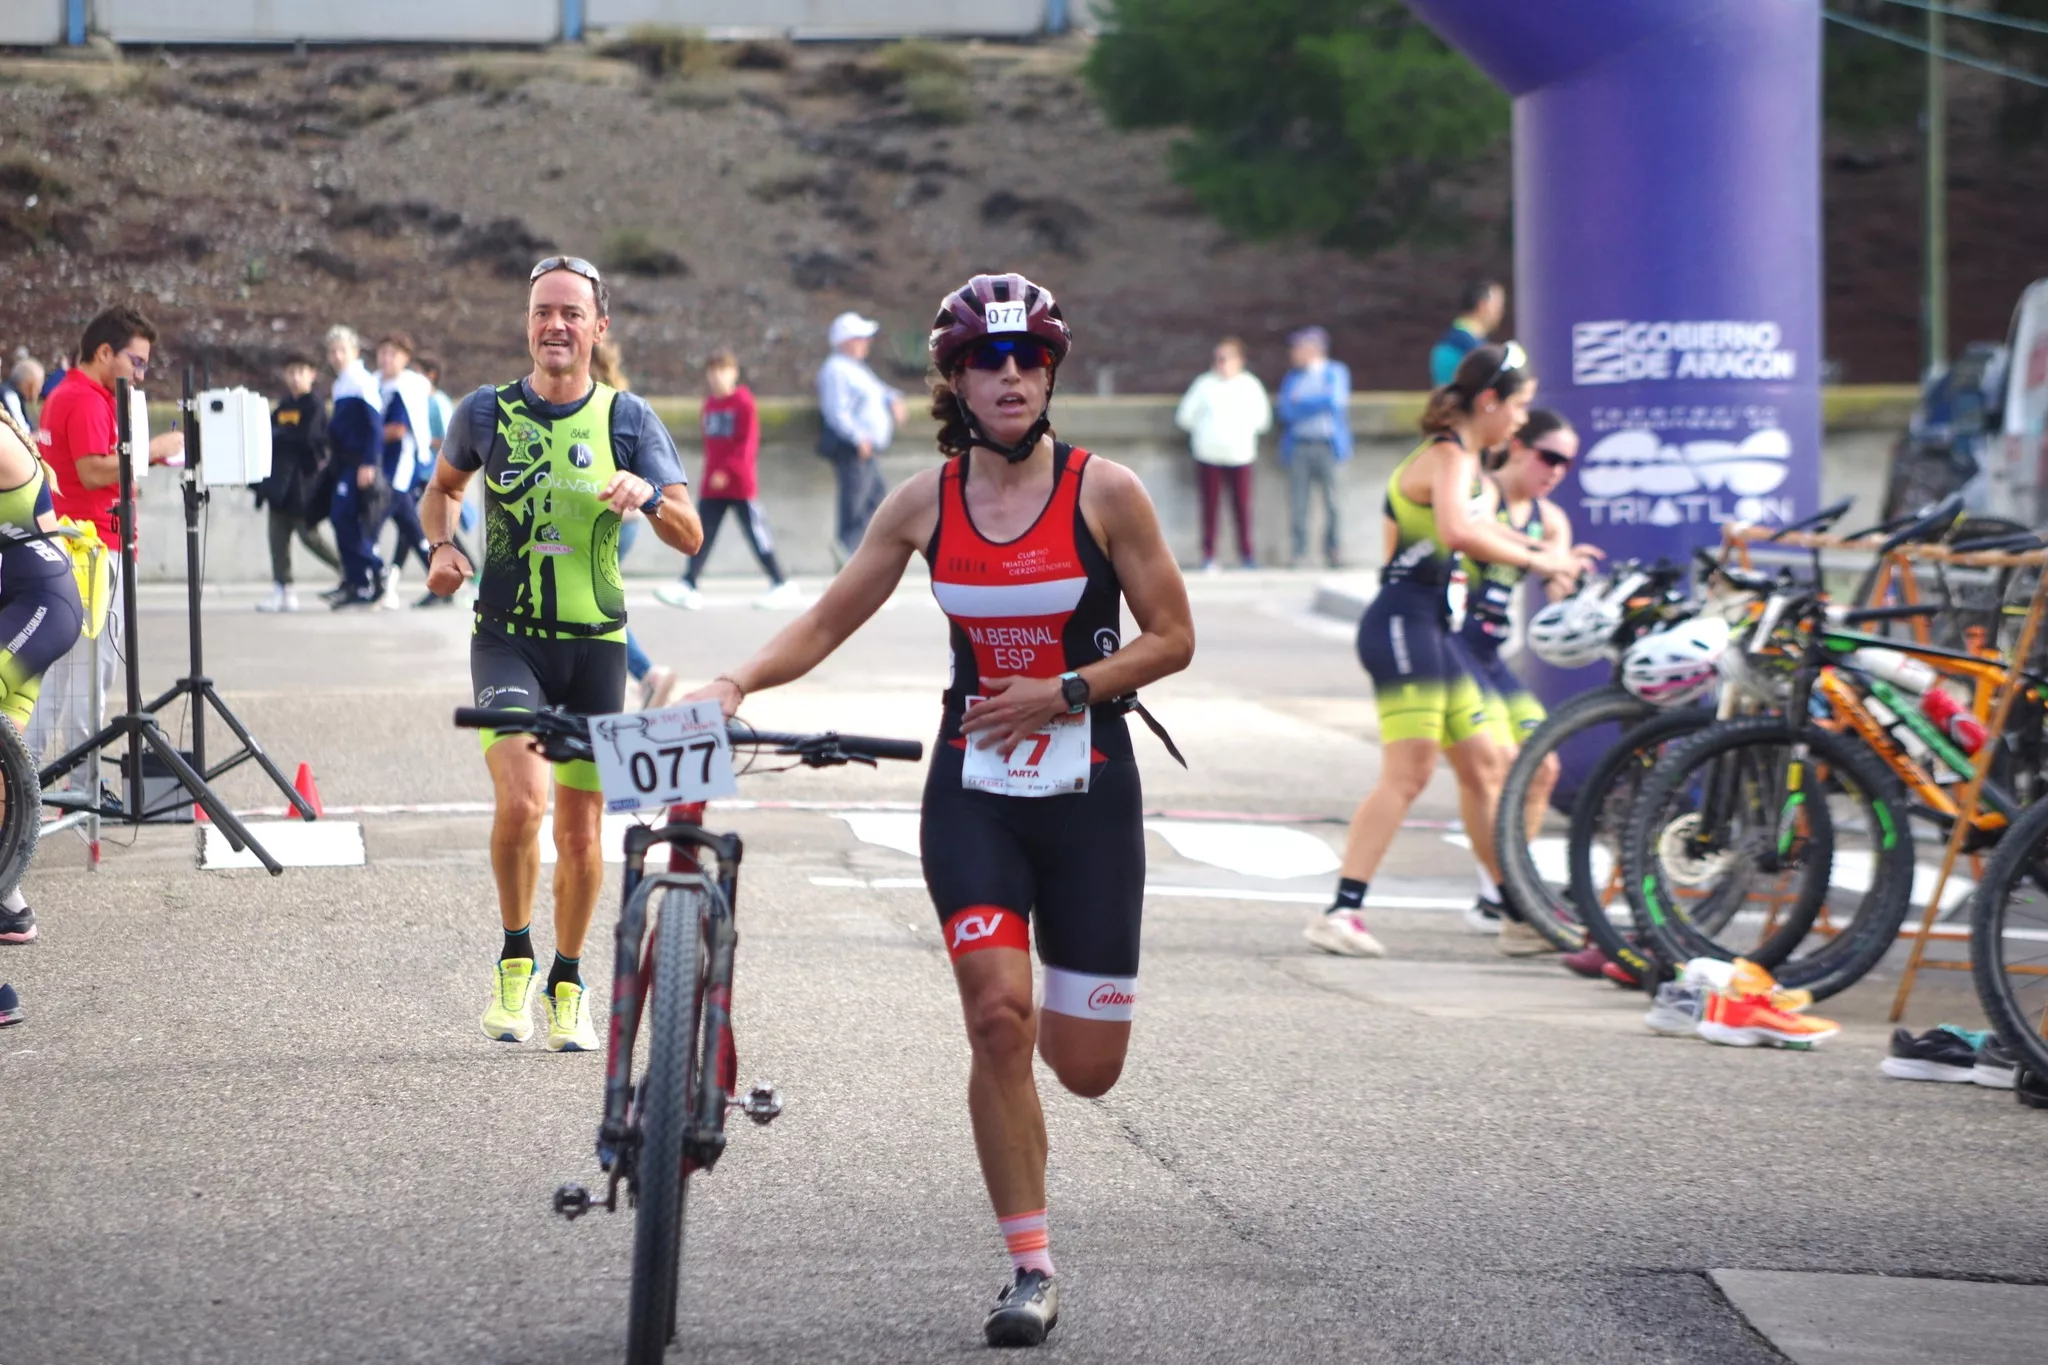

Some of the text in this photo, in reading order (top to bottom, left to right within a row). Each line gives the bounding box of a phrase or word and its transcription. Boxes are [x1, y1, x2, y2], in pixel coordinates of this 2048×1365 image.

[988, 308, 1024, 324] 077
[1623, 321, 1782, 350] GOBIERNO
[1624, 350, 1671, 380] DE
[500, 469, 602, 495] El Olivar
[1002, 558, 1036, 569] TRIATLON
[1017, 550, 1036, 559] CLUB
[1009, 567, 1037, 576] CIERZO
[7, 605, 48, 654] STADIUM CASABLANCA
[968, 625, 1059, 647] M.BERNAL
[994, 648, 1036, 670] ESP
[630, 740, 716, 793] 077
